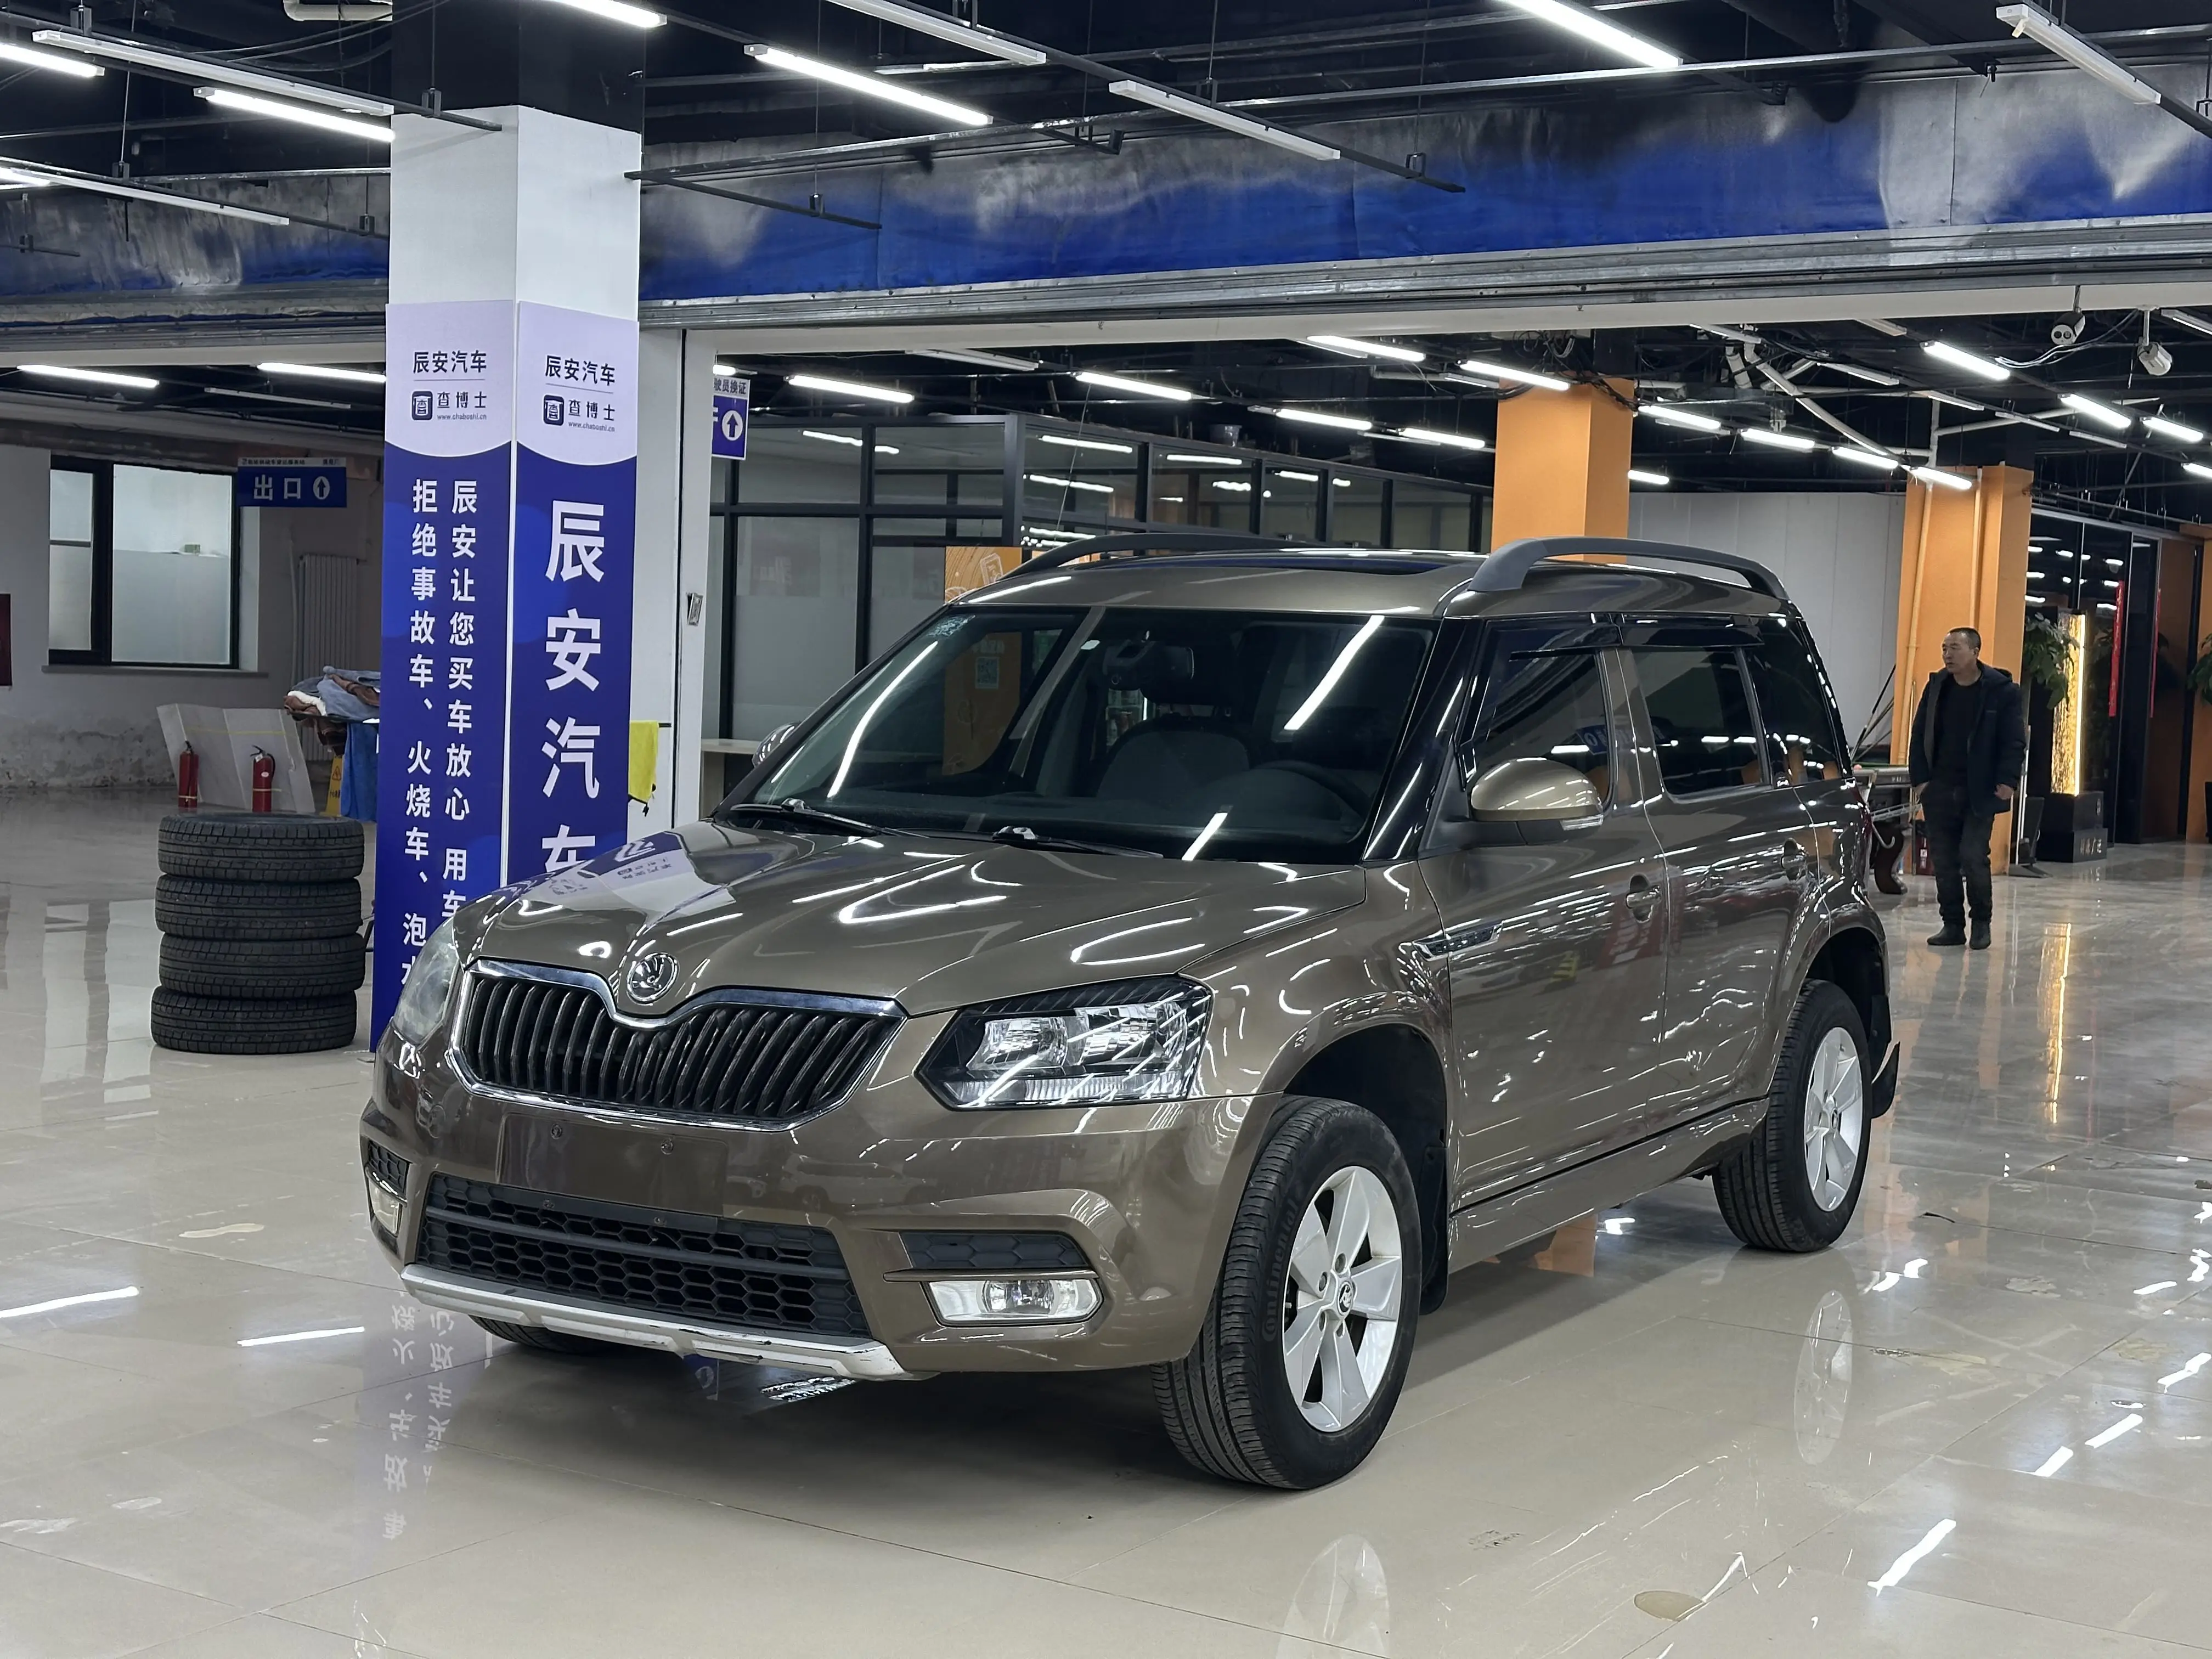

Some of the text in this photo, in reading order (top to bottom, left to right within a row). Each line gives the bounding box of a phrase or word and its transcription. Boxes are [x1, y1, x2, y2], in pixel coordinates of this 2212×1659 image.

[413, 349, 487, 374] 辰安汽车
[545, 355, 615, 386] 辰安汽车
[437, 391, 487, 408] 查博士
[568, 399, 615, 421] 查博士
[568, 422, 615, 432] www.chaboshi.cn
[253, 475, 301, 500] 出口
[541, 500, 605, 873] 辰安汽车
[1262, 1198, 1298, 1341] Continental
